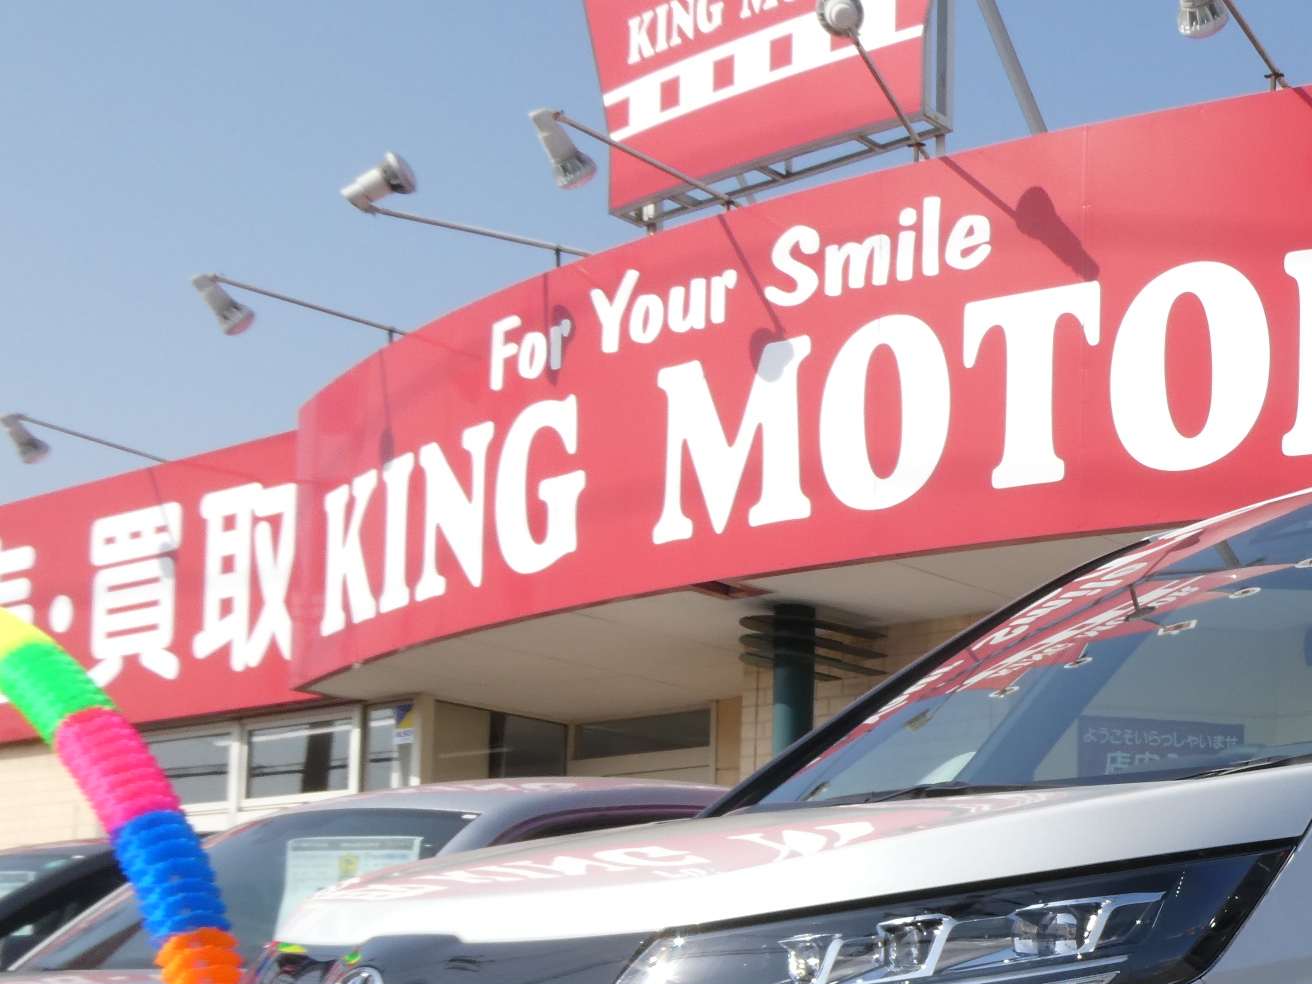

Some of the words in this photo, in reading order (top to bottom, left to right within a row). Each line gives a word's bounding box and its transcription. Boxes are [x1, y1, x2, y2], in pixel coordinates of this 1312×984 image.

[627, 0, 725, 65] KING
[490, 315, 572, 391] For
[590, 269, 738, 354] Your
[764, 196, 992, 307] Smile
[320, 394, 586, 637] KING
